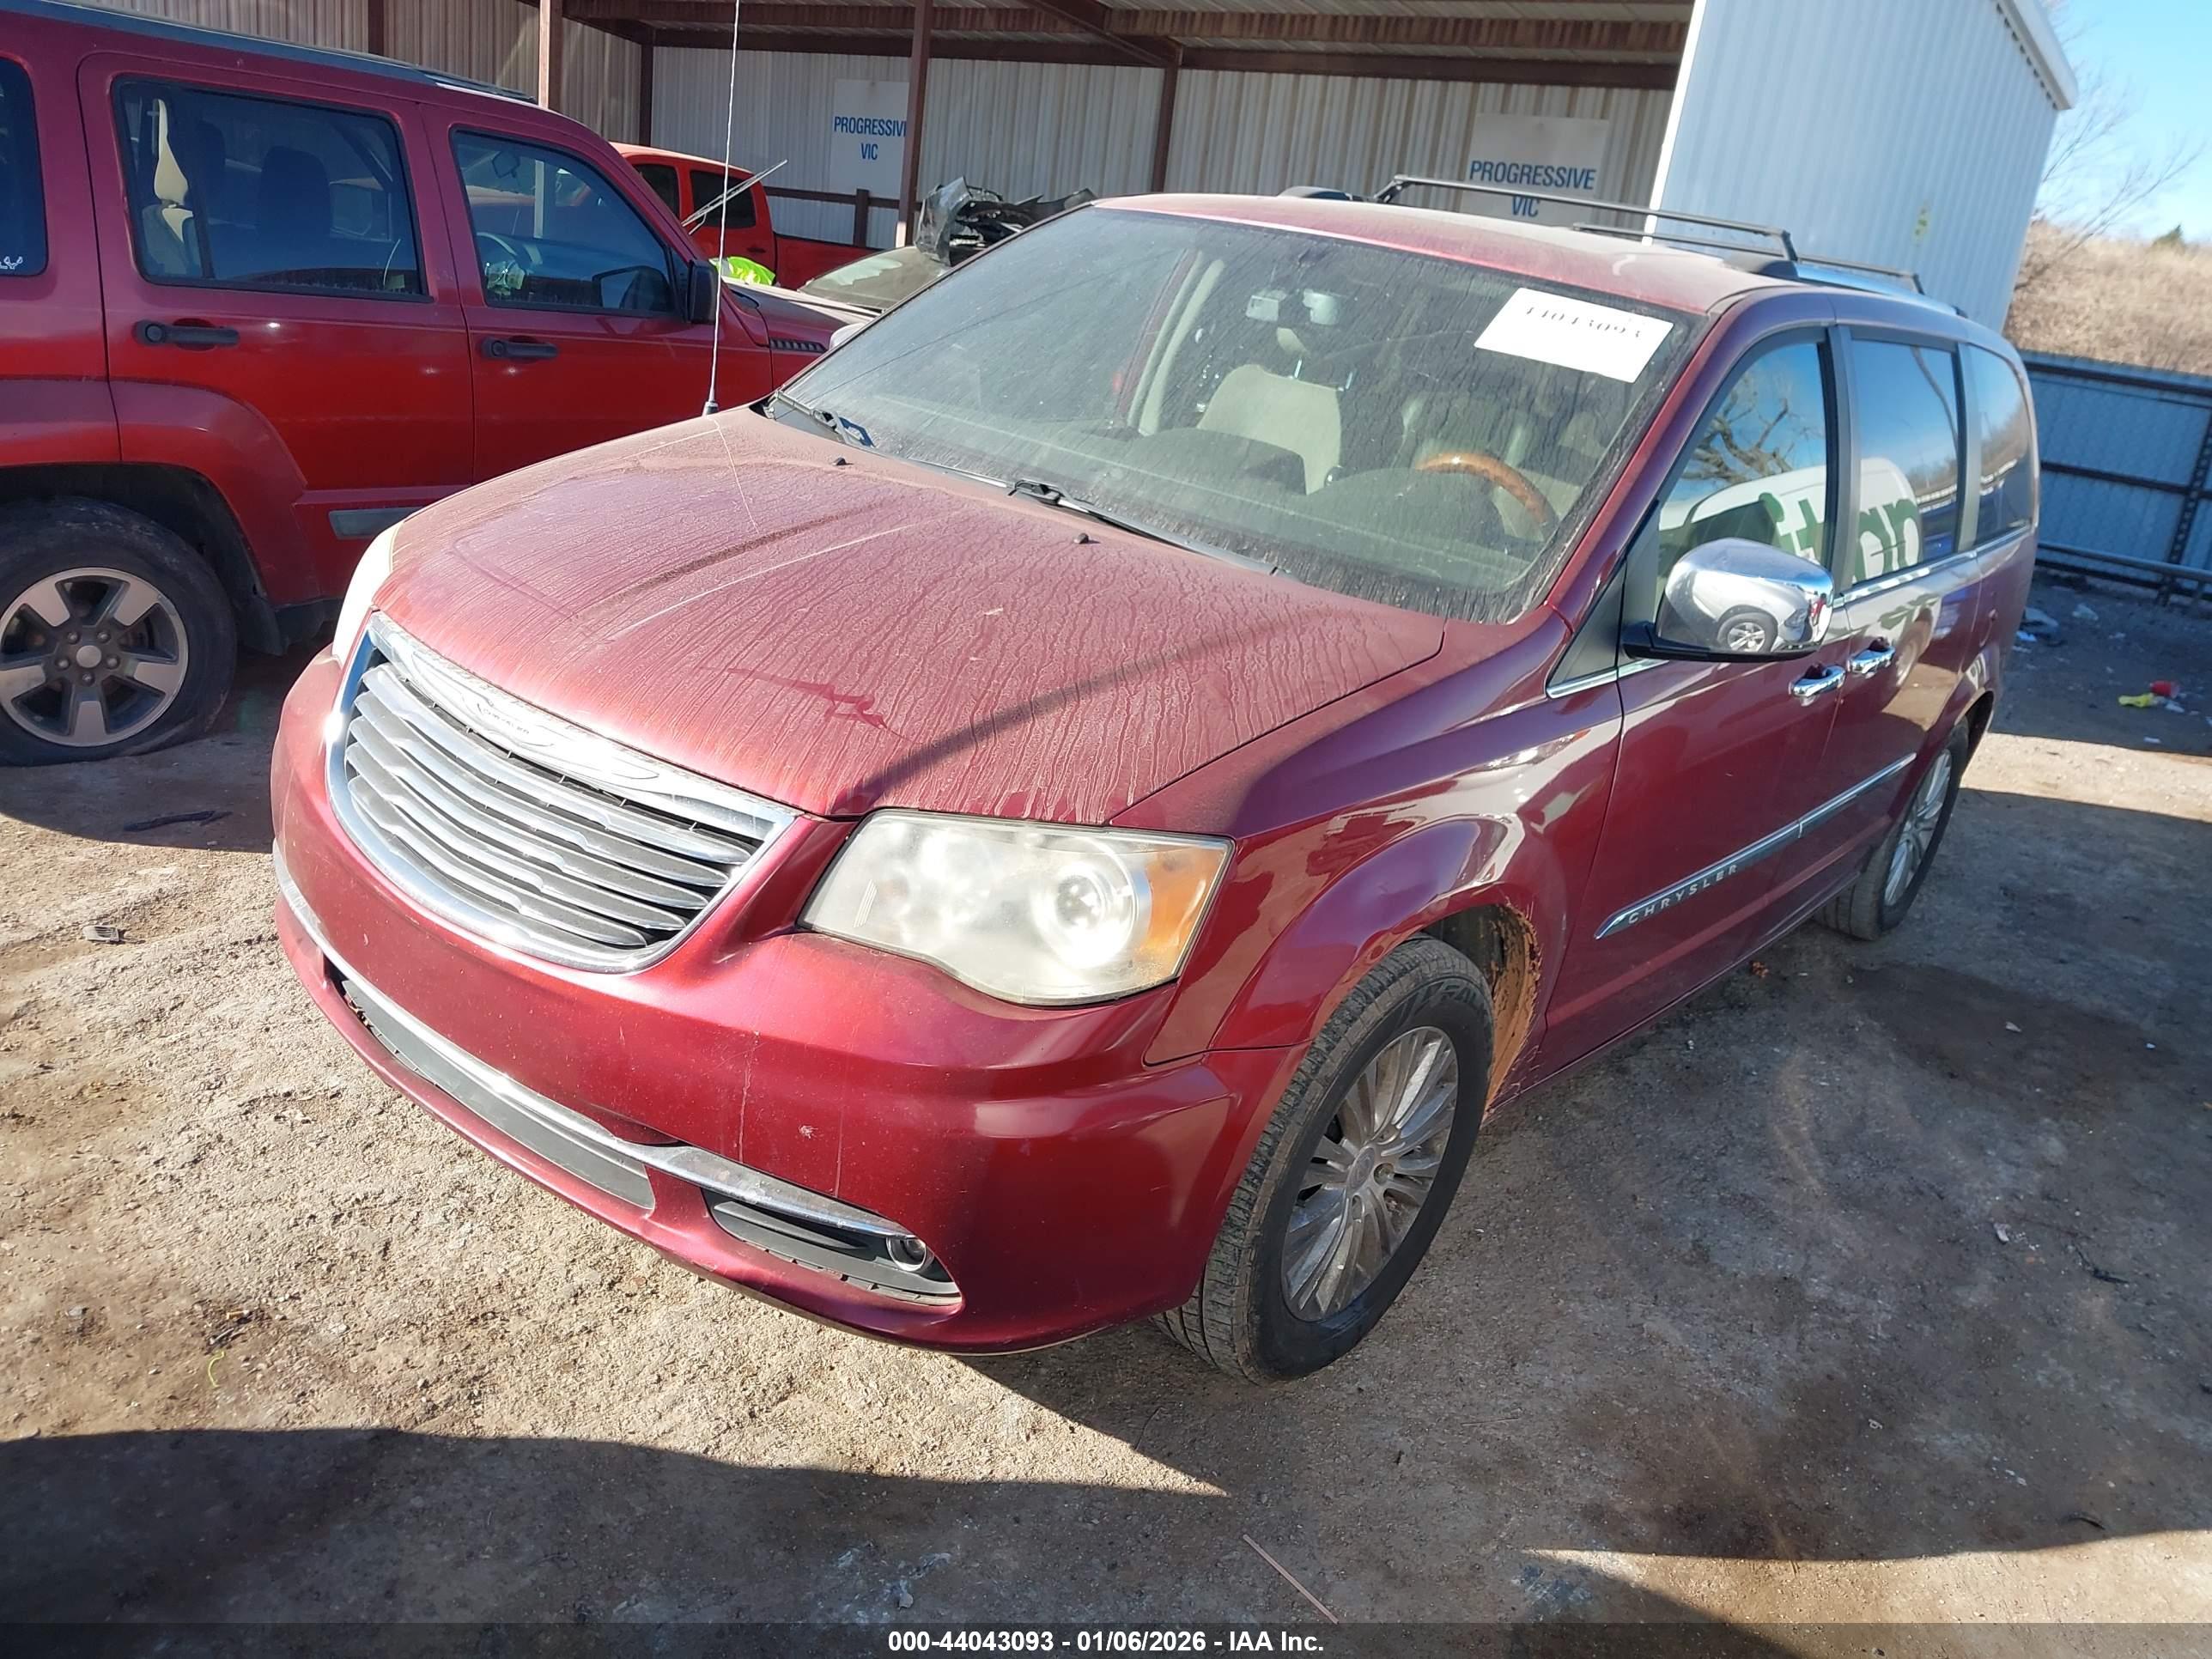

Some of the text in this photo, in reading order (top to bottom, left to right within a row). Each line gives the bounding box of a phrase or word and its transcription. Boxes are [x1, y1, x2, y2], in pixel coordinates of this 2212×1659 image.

[834, 116, 907, 137] PROGRESSIV
[860, 143, 878, 161] VIC
[1469, 160, 1597, 191] PROGRESSIVE
[1511, 196, 1540, 217] VIC
[1628, 864, 1738, 925] CHRYSLER
